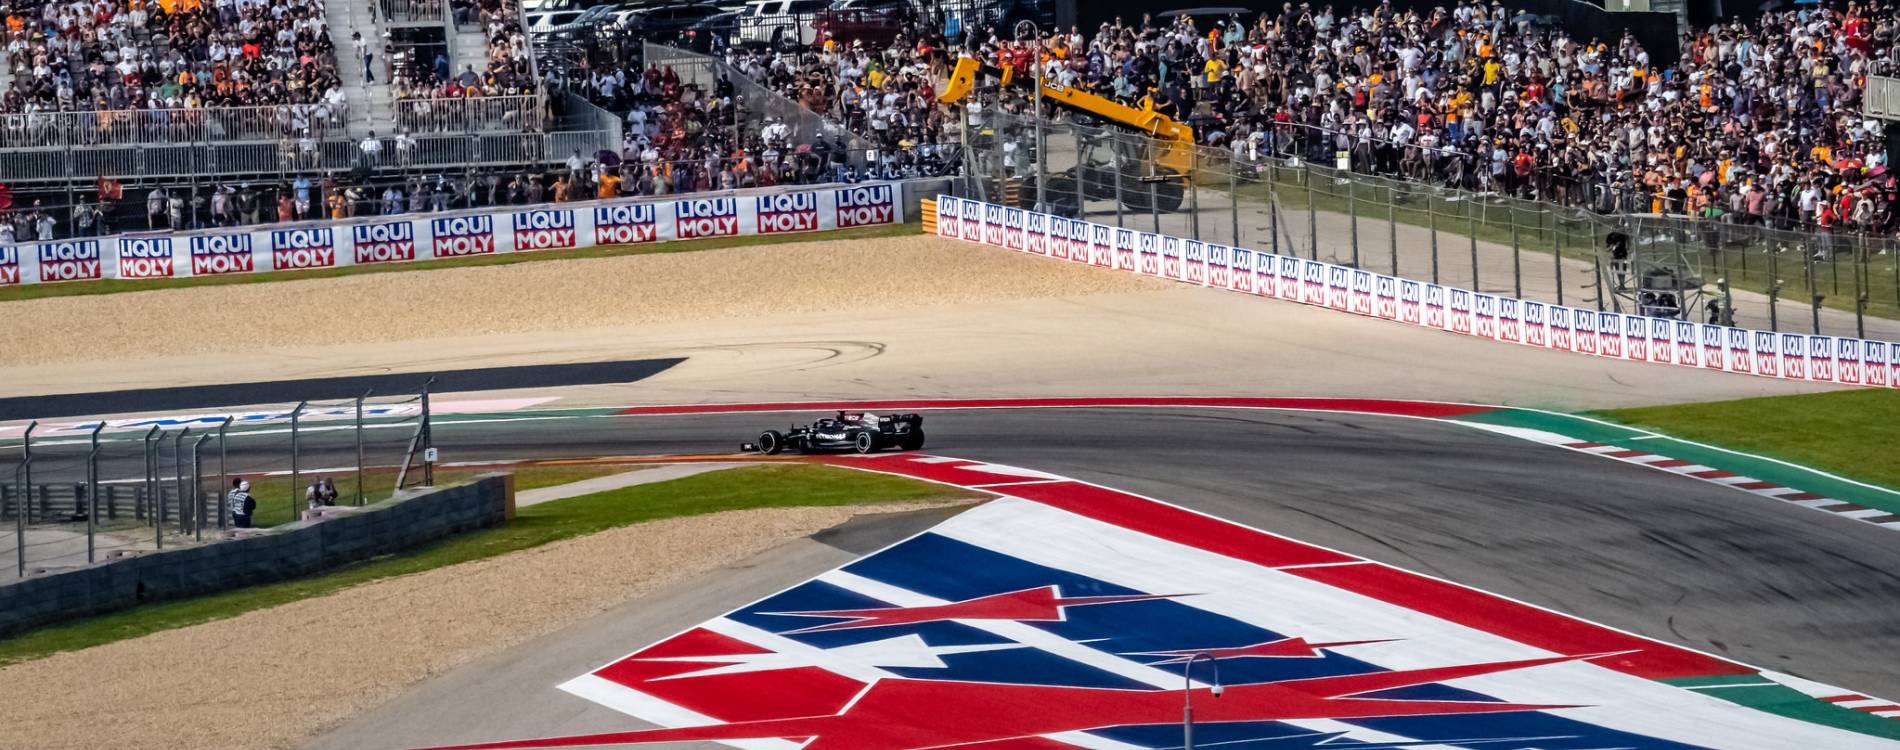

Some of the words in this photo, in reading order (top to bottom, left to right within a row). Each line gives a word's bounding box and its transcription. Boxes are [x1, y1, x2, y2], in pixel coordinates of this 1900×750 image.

[1044, 81, 1063, 91] JCB
[759, 193, 815, 213] LIQUI
[838, 186, 891, 207] LIQUI
[596, 206, 653, 225] LIQUI
[678, 199, 735, 218] LIQUI
[839, 206, 892, 226] MOLY
[941, 198, 958, 216] LIQUI
[964, 201, 979, 220] LIQUI
[987, 205, 1002, 224] LIQUI
[435, 216, 490, 237] LIQUI
[515, 210, 572, 230] LIQUI
[680, 217, 736, 238] MOLY
[761, 212, 816, 232] MOLY
[1006, 209, 1023, 228] LIQUI
[1029, 214, 1045, 233] LIQUI
[1052, 218, 1068, 238] LIQUI
[275, 230, 331, 250] LIQUI
[356, 223, 411, 243] LIQUI
[518, 230, 573, 249] MOLY
[598, 225, 655, 244] MOLY
[1072, 222, 1088, 242] LIQUI
[1094, 226, 1110, 245] LIQUI
[1118, 231, 1133, 249] LIQUI
[41, 241, 97, 261] LIQUI
[120, 238, 170, 258] LIQUI
[193, 235, 250, 255] LIQUI
[358, 242, 413, 262] MOLY
[436, 235, 492, 256] MOLY
[1141, 234, 1156, 253] LIQUI
[1164, 237, 1179, 257] LIQUI
[1187, 242, 1203, 261] LIQUI
[194, 254, 252, 273] MOLY
[276, 249, 332, 268] MOLY
[1209, 246, 1227, 265] LIQUI
[1234, 250, 1251, 270] LIQUI
[1258, 255, 1274, 275] LIQUI
[0, 265, 18, 284] LY
[43, 260, 98, 280] MOLY
[122, 258, 171, 277] MOLY
[1282, 259, 1298, 279] LIQUI
[1306, 263, 1323, 283] LIQUI
[1331, 268, 1347, 288] LIQUI
[1354, 272, 1370, 293] LIQUI
[1378, 277, 1394, 297] LIQUI
[1402, 282, 1418, 302] LIQUI
[1427, 286, 1443, 306] LIQUI
[1452, 291, 1469, 311] LIQUI
[1476, 296, 1494, 315] LIQUI
[1501, 299, 1518, 319] LIQUI
[1526, 303, 1543, 323] LIQUI
[1551, 308, 1568, 328] LIQUI
[1575, 311, 1594, 331] LIQUI
[1600, 314, 1619, 334] LIQUI
[1627, 318, 1645, 338] LIQUI
[1653, 320, 1670, 340] LIQUI
[1678, 323, 1695, 343] LIQUI
[1704, 326, 1721, 346] LIQUI
[1729, 329, 1748, 349] LIQUI
[1757, 333, 1776, 352] LIQUI
[1784, 336, 1803, 356] LIQUI
[1811, 338, 1831, 358] LIQUI
[1839, 340, 1858, 360] LIQUI
[1866, 342, 1885, 363] LIQUI
[429, 451, 434, 459] F
